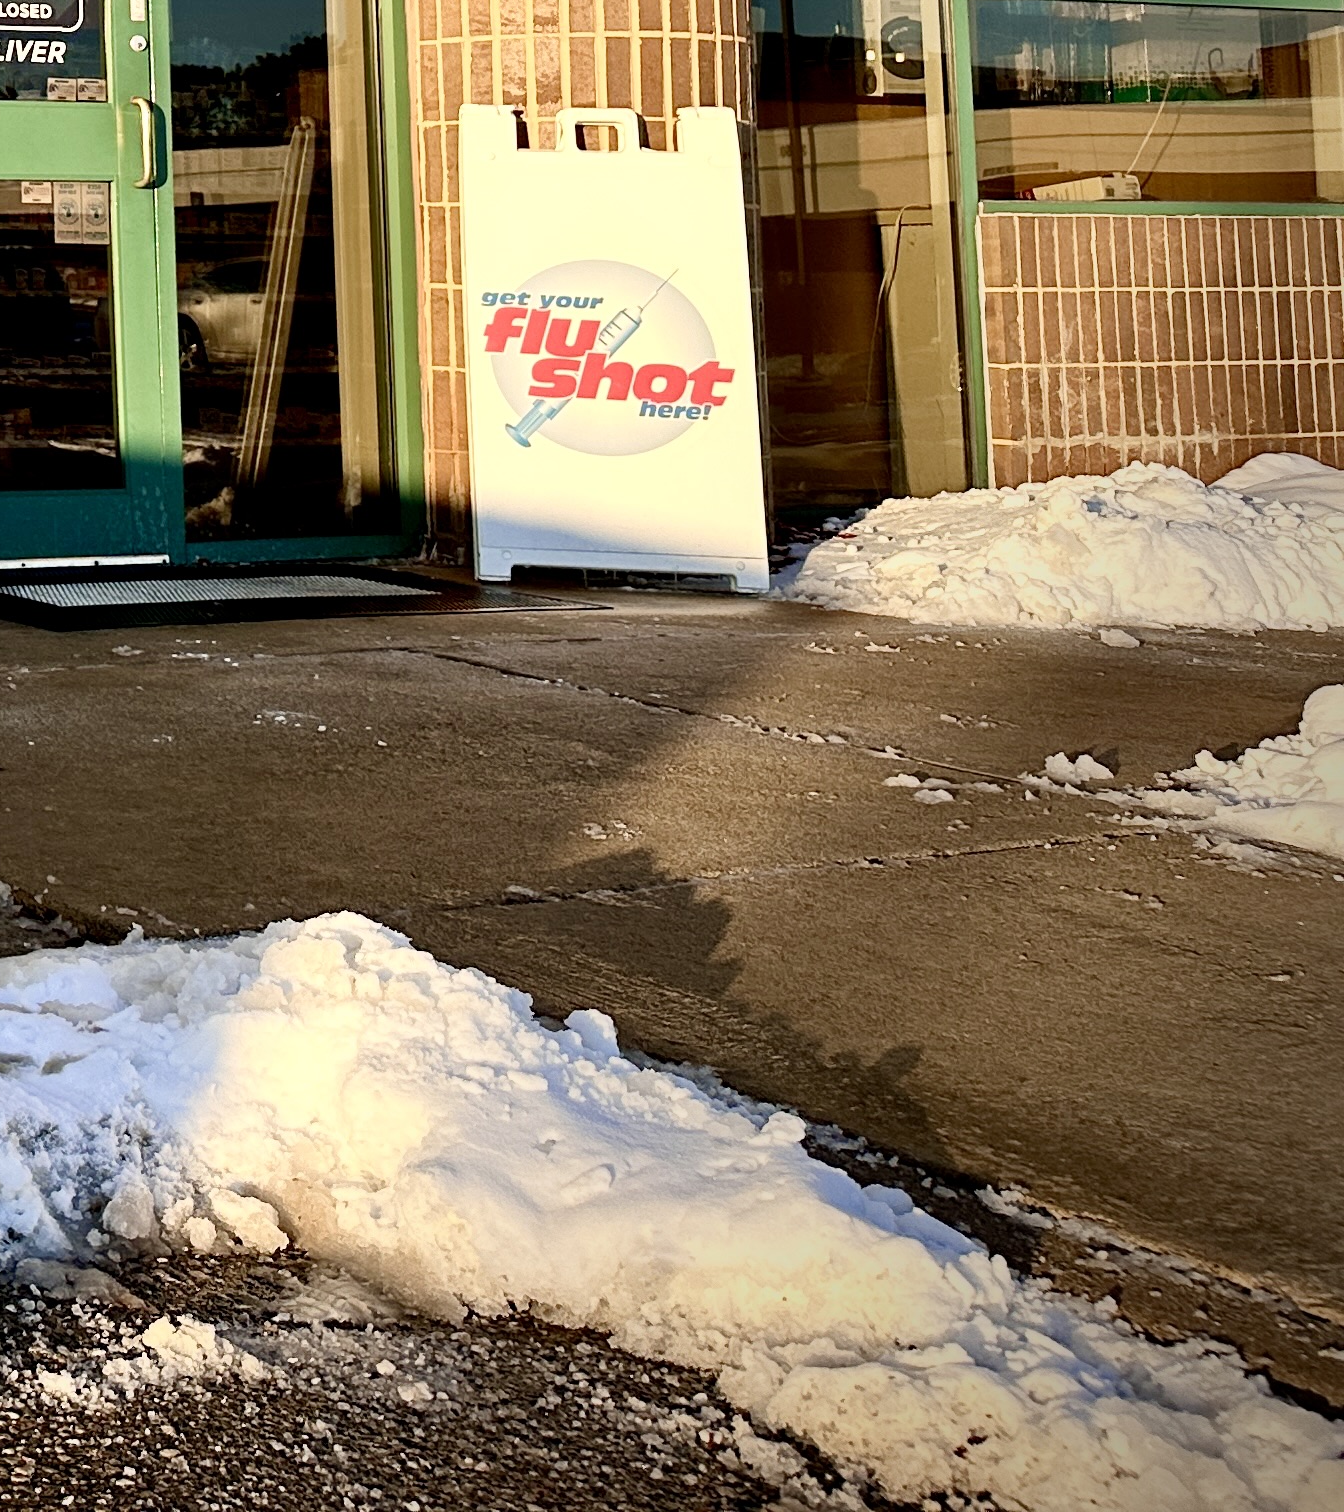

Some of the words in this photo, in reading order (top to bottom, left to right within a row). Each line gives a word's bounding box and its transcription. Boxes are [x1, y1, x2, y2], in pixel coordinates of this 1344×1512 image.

[481, 292, 531, 306] get
[539, 294, 604, 309] your
[483, 307, 601, 357] flu
[528, 353, 735, 406] shot
[639, 401, 712, 420] here!
